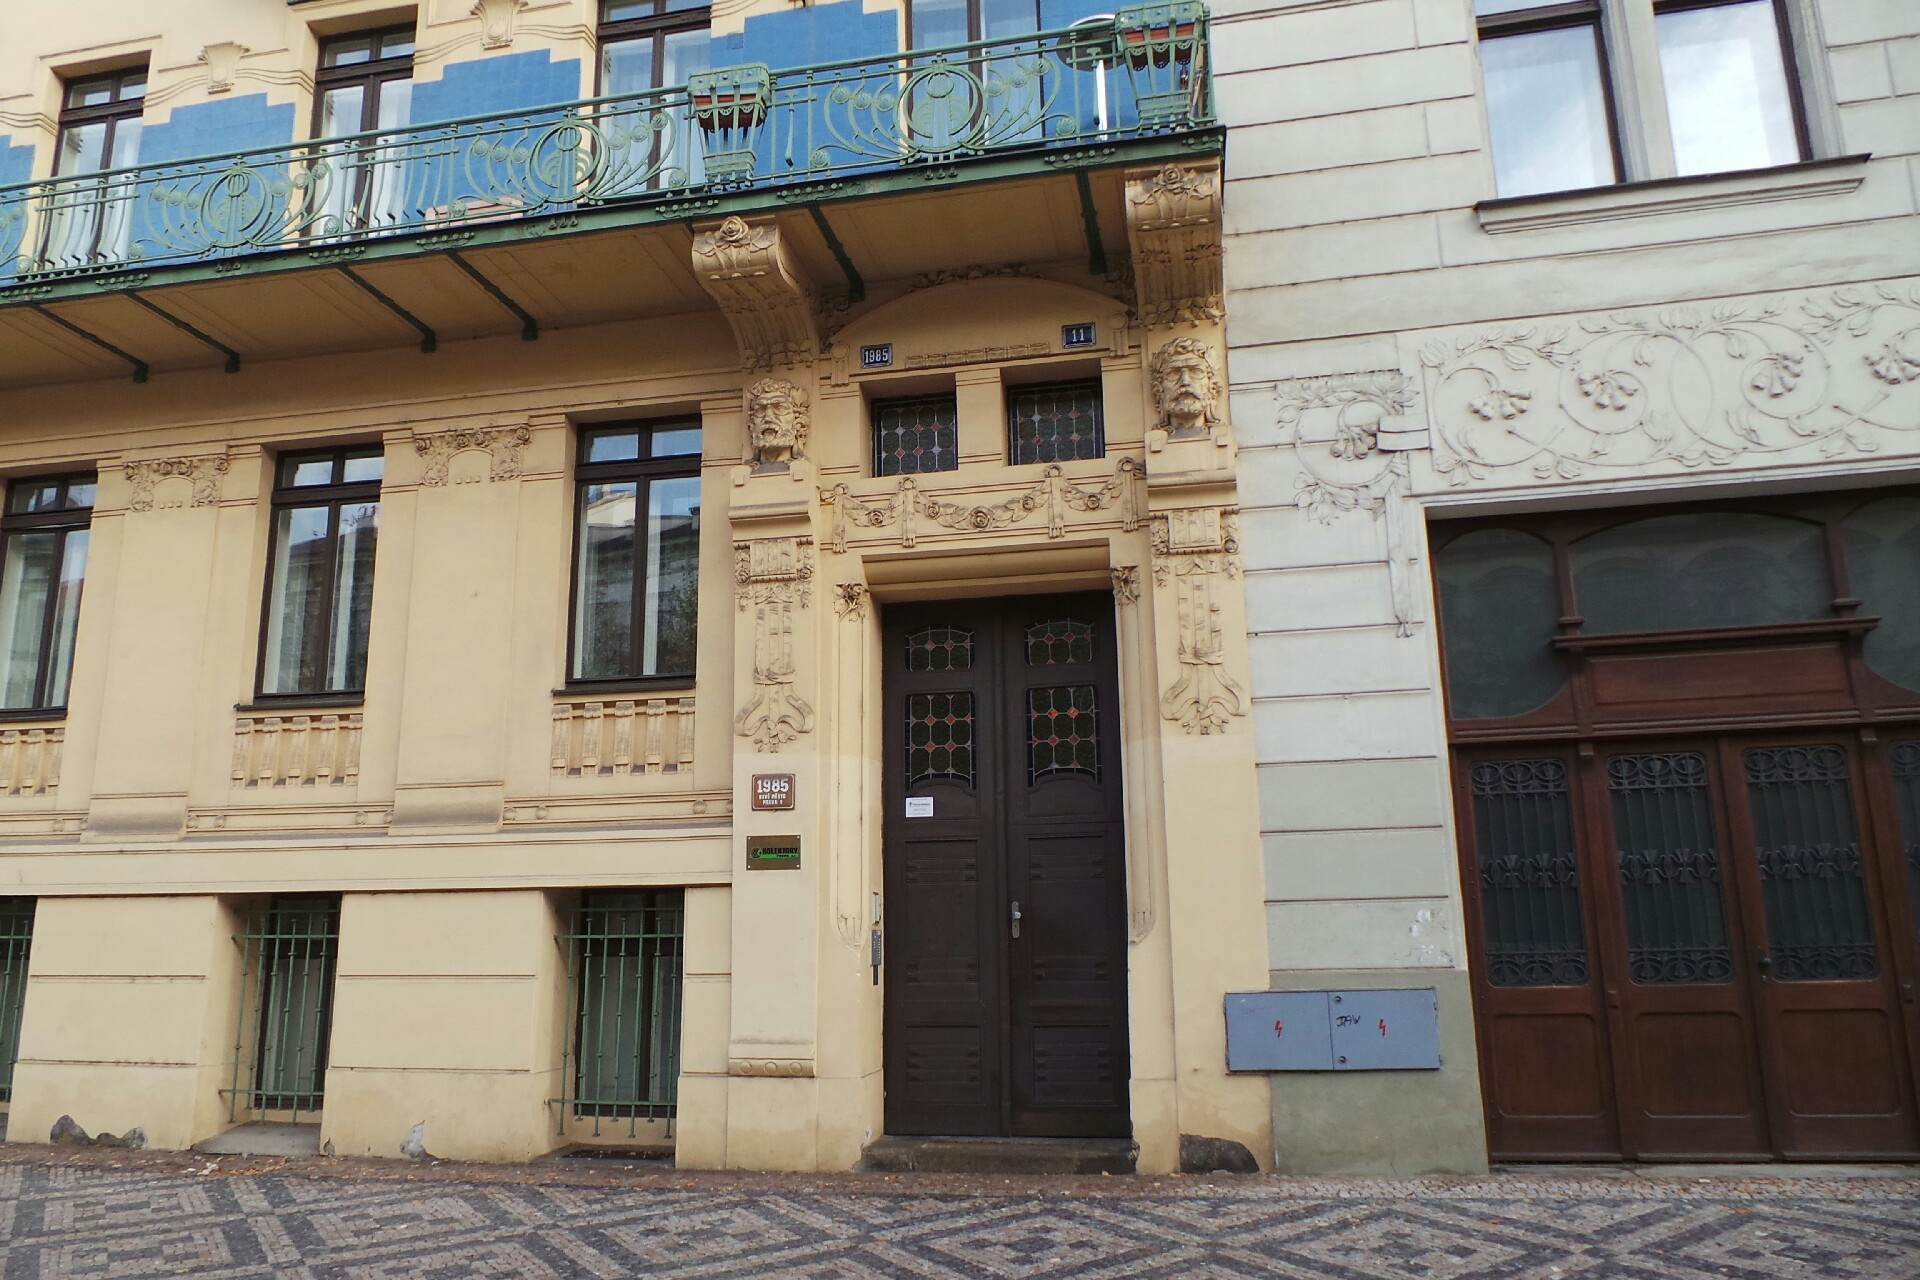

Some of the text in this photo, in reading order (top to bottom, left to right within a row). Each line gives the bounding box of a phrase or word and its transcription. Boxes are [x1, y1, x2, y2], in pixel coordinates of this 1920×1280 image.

[1072, 328, 1085, 342] 11
[864, 348, 889, 363] 1985
[757, 778, 789, 793] 1985
